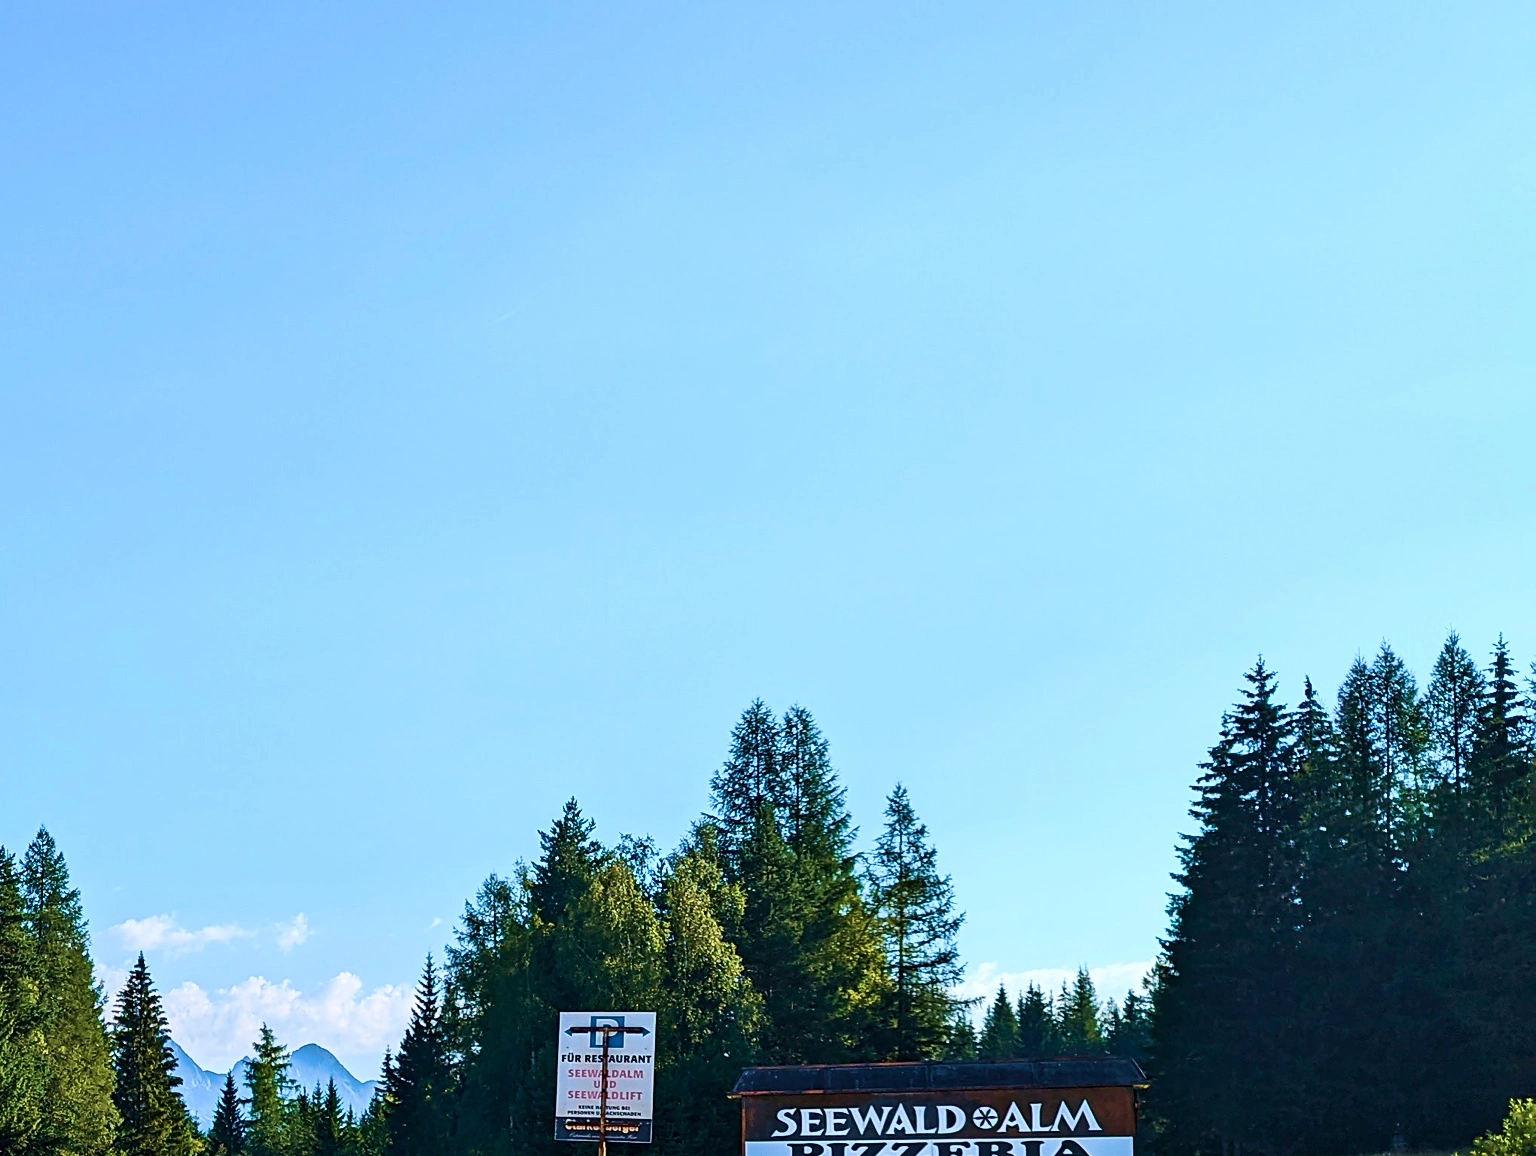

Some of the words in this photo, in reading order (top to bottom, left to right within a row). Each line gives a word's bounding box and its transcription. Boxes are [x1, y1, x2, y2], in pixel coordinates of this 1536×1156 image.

[561, 1052, 581, 1063] FÜR
[585, 1054, 652, 1064] RESAURANT
[771, 1103, 967, 1137] SEEWALD
[996, 1098, 1103, 1134] ALM
